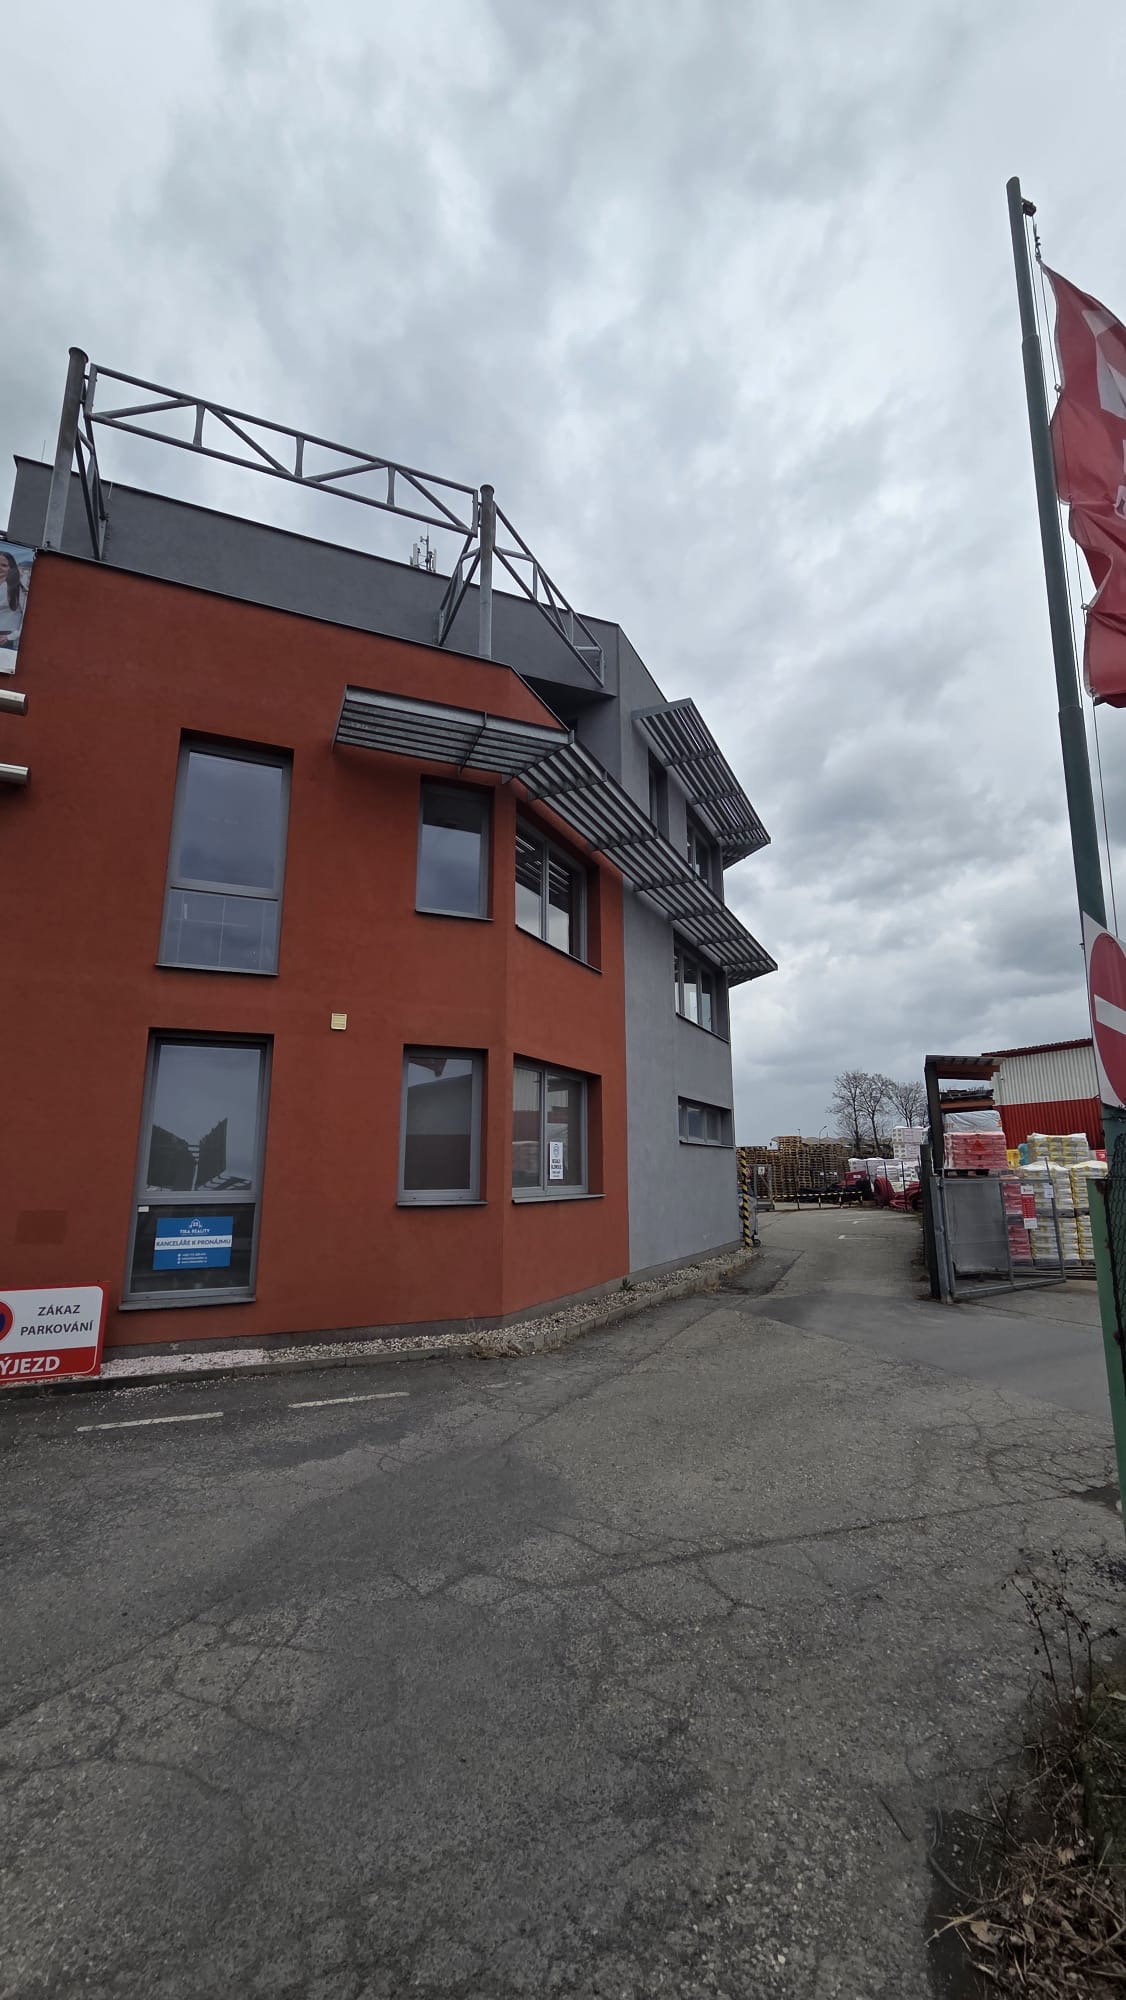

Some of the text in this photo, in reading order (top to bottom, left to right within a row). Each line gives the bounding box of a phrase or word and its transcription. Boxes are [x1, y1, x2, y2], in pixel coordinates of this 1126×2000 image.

[156, 1239, 191, 1247] KANCELÁŘE
[38, 1303, 81, 1316] ZÁKAZ
[20, 1319, 94, 1336] PARKOVÁNÍ
